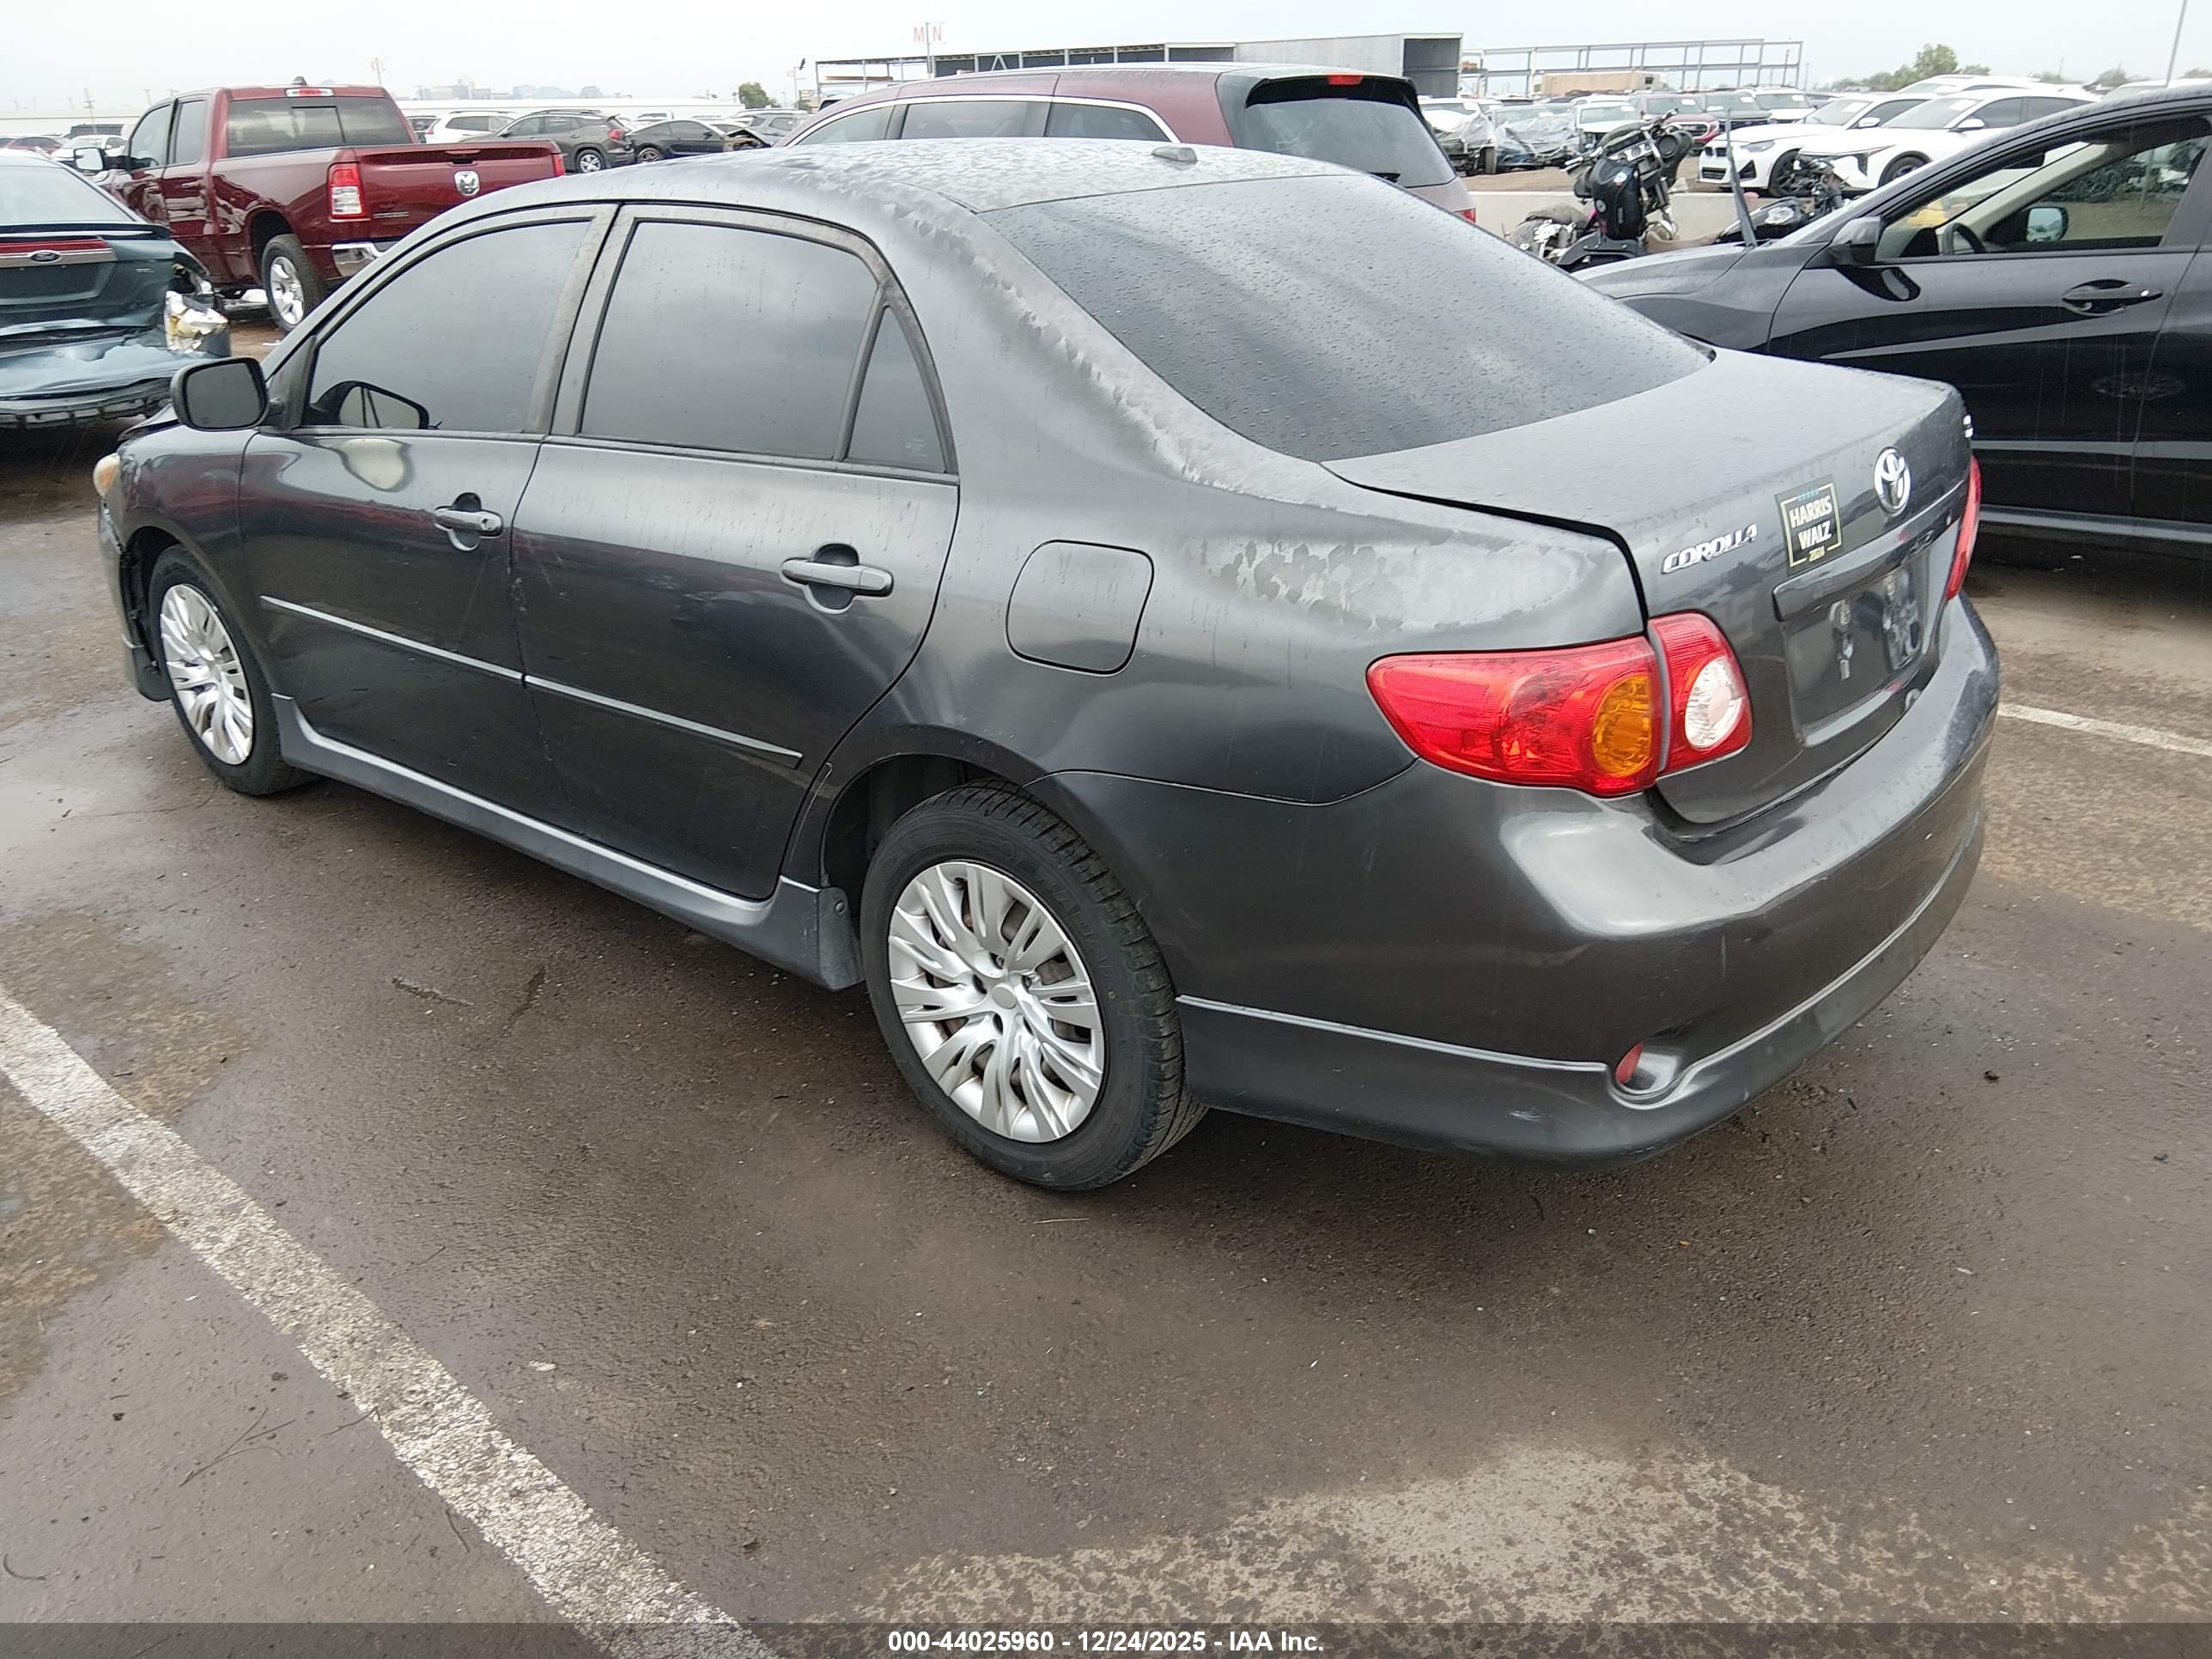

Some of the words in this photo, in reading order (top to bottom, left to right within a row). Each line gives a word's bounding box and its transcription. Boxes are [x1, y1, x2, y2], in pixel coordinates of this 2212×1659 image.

[914, 27, 925, 42] M
[933, 26, 942, 41] N
[1789, 495, 1833, 529] HARRIS
[1662, 523, 1759, 574] COROLLA
[1797, 520, 1832, 550] WALZ
